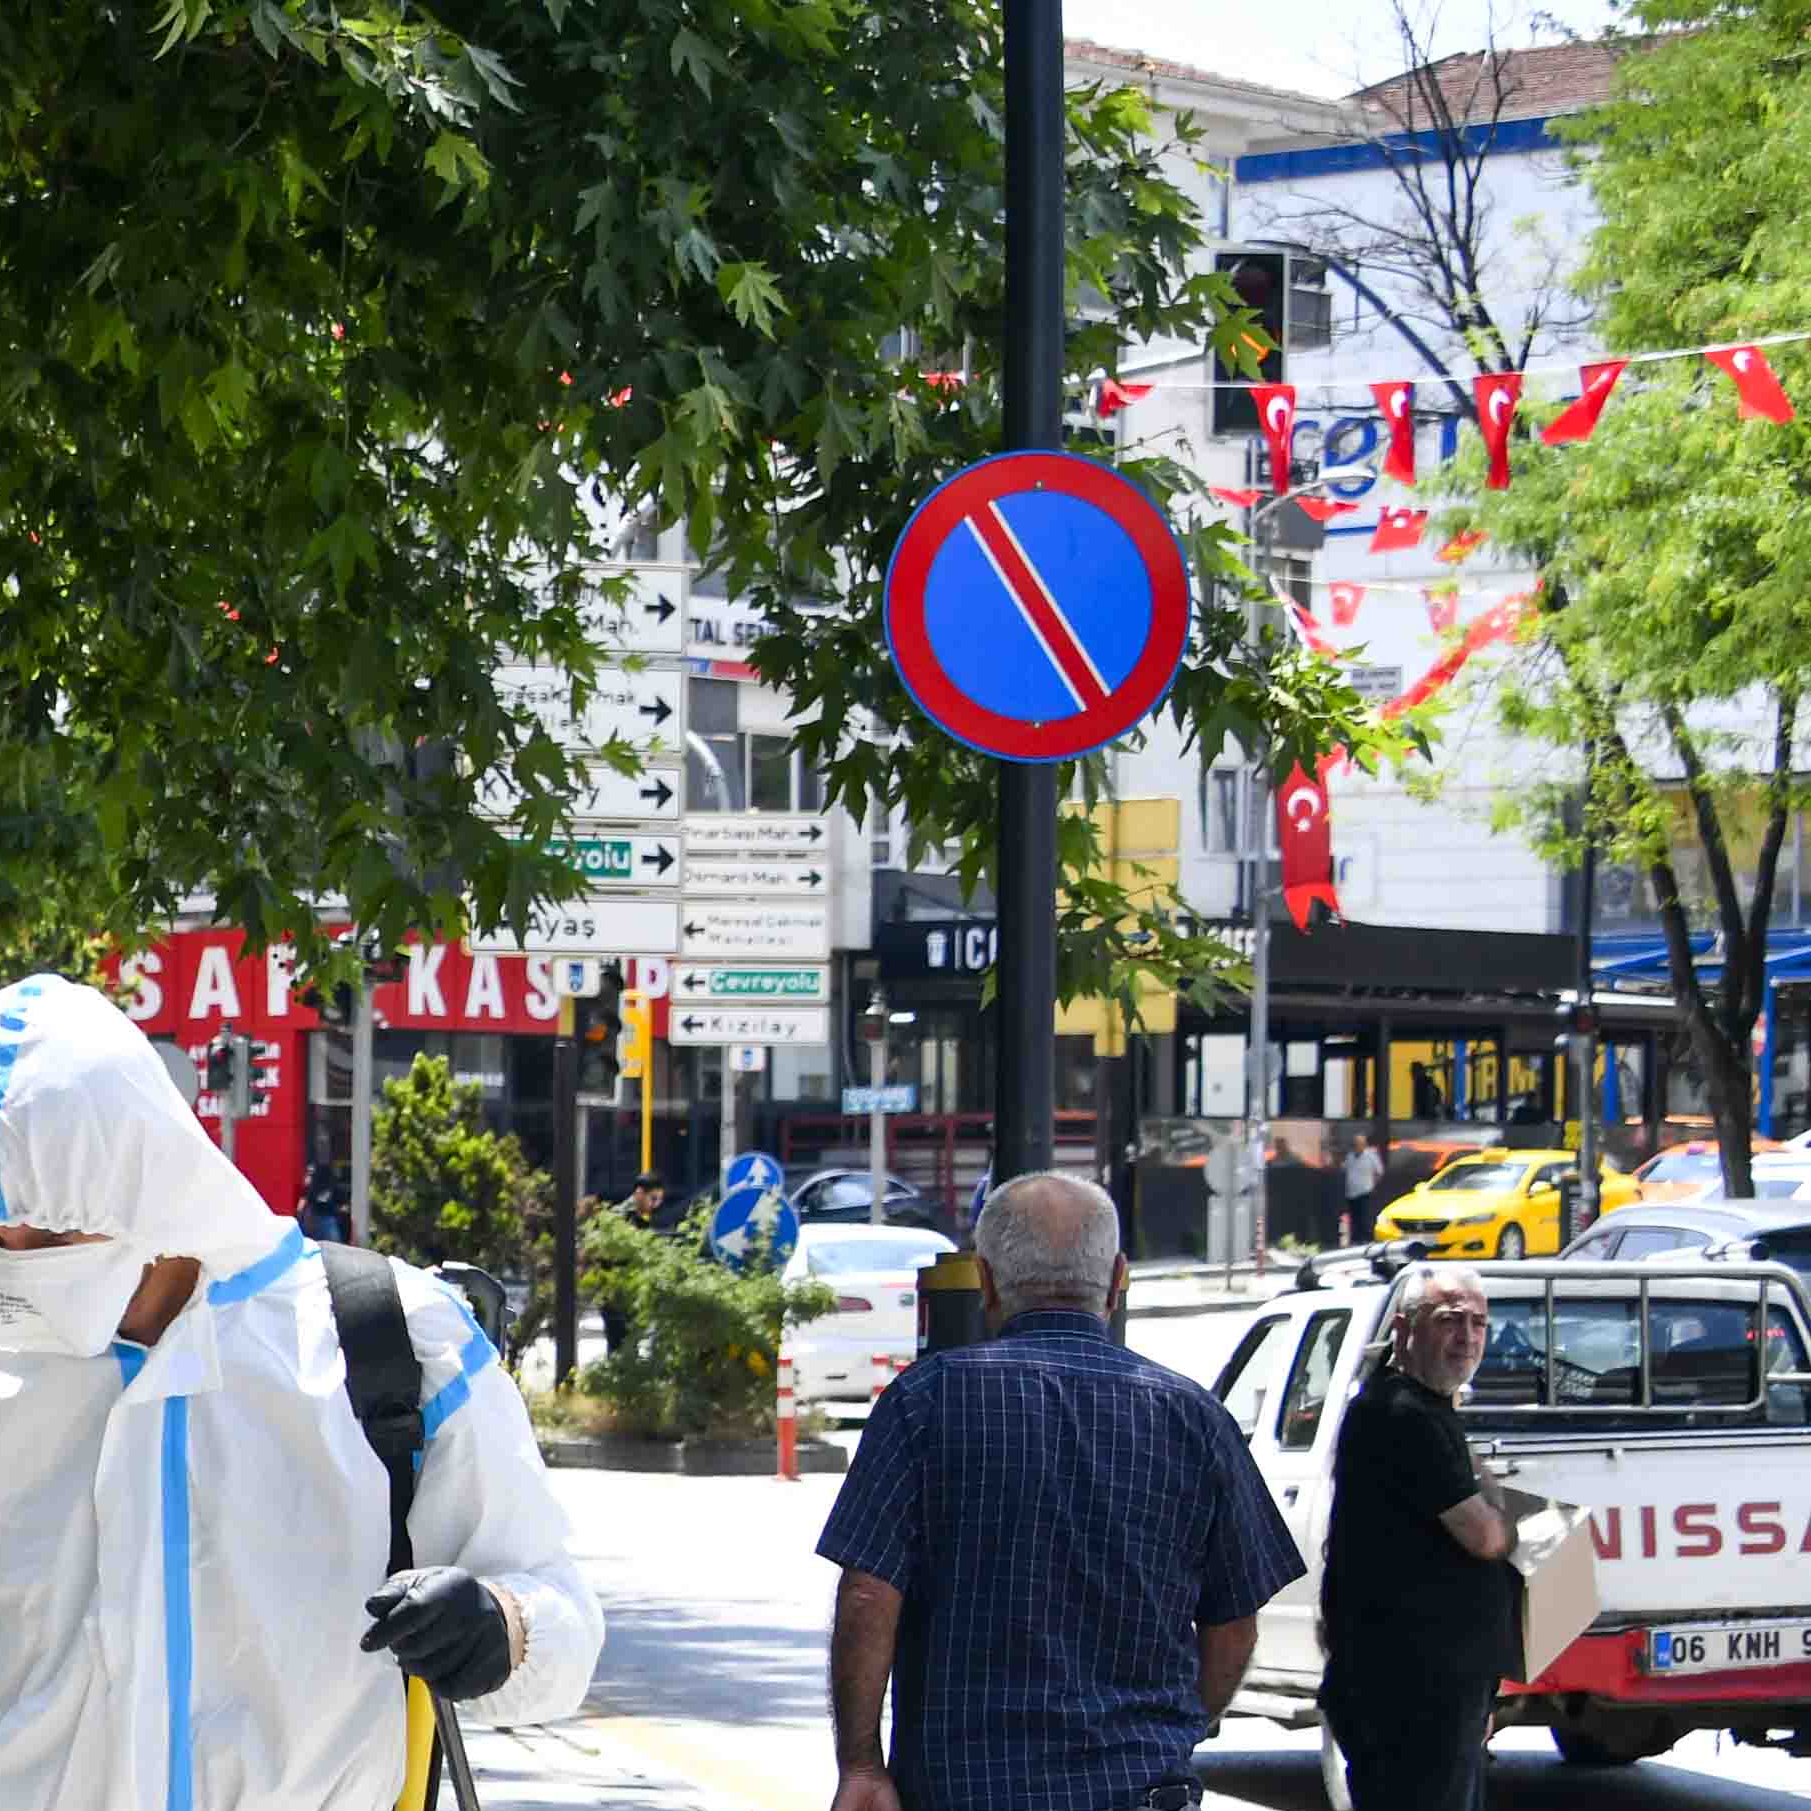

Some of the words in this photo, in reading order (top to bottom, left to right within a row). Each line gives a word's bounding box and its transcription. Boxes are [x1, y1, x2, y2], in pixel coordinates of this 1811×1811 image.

[526, 911, 597, 943] Ayaş
[1672, 1636, 1707, 1664] 06
[1727, 1630, 1781, 1661] KNH
